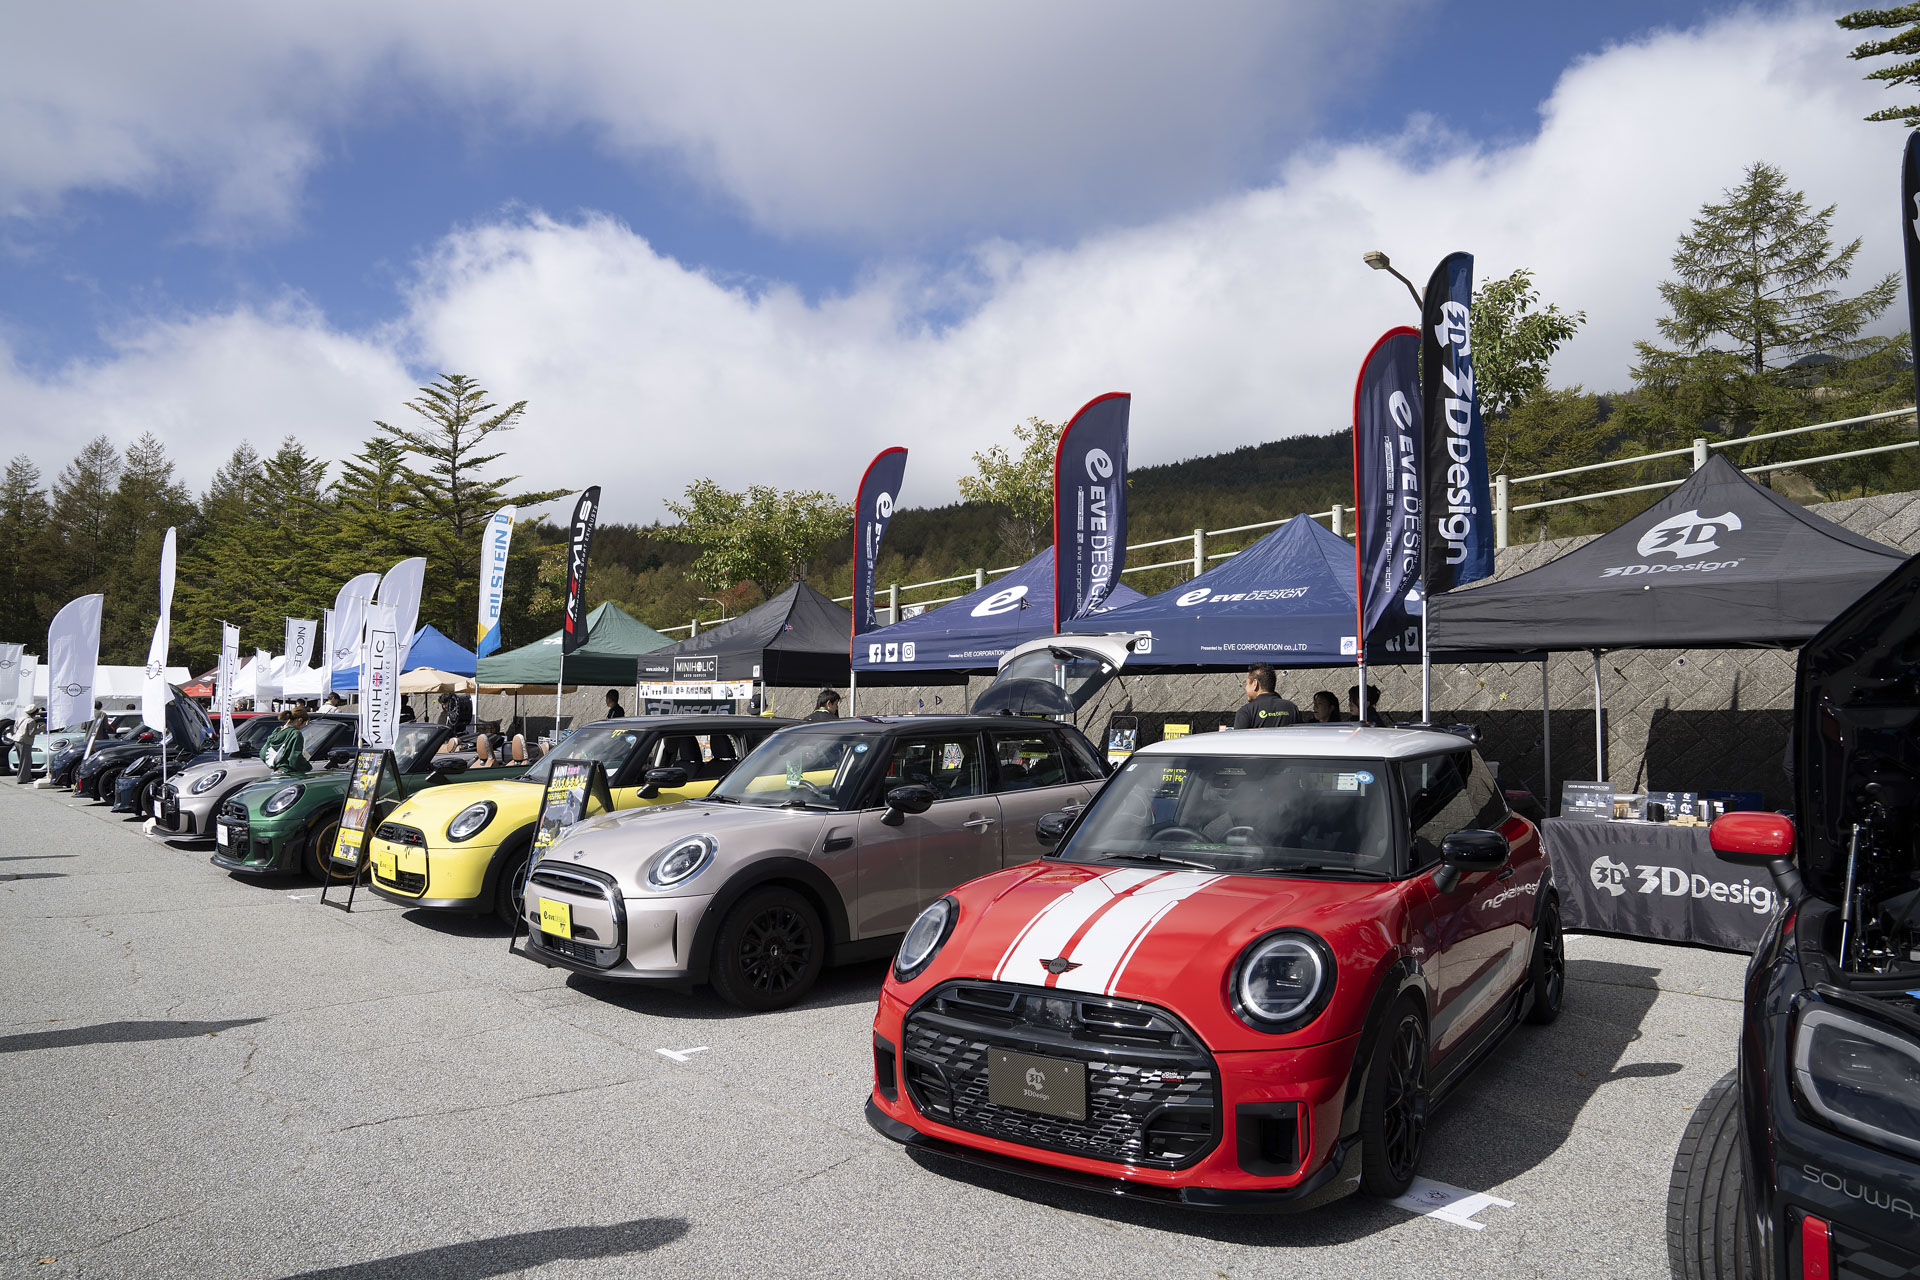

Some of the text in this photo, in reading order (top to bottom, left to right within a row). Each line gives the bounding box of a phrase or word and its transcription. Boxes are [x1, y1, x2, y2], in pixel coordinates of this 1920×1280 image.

[1438, 364, 1477, 565] 3DDesign
[584, 504, 598, 542] EXHAUSTS
[1090, 485, 1107, 531] EVE
[1399, 435, 1419, 574] EVE DESIG
[1108, 535, 1114, 545] We
[1385, 531, 1393, 593] corporation
[566, 500, 592, 630] REMUS
[1599, 560, 1739, 578] 3DDesign
[1209, 594, 1247, 603] EVE
[1244, 589, 1309, 601] DESIGN
[293, 626, 306, 667] NICOLE
[1634, 864, 1772, 915] 3DDesig
